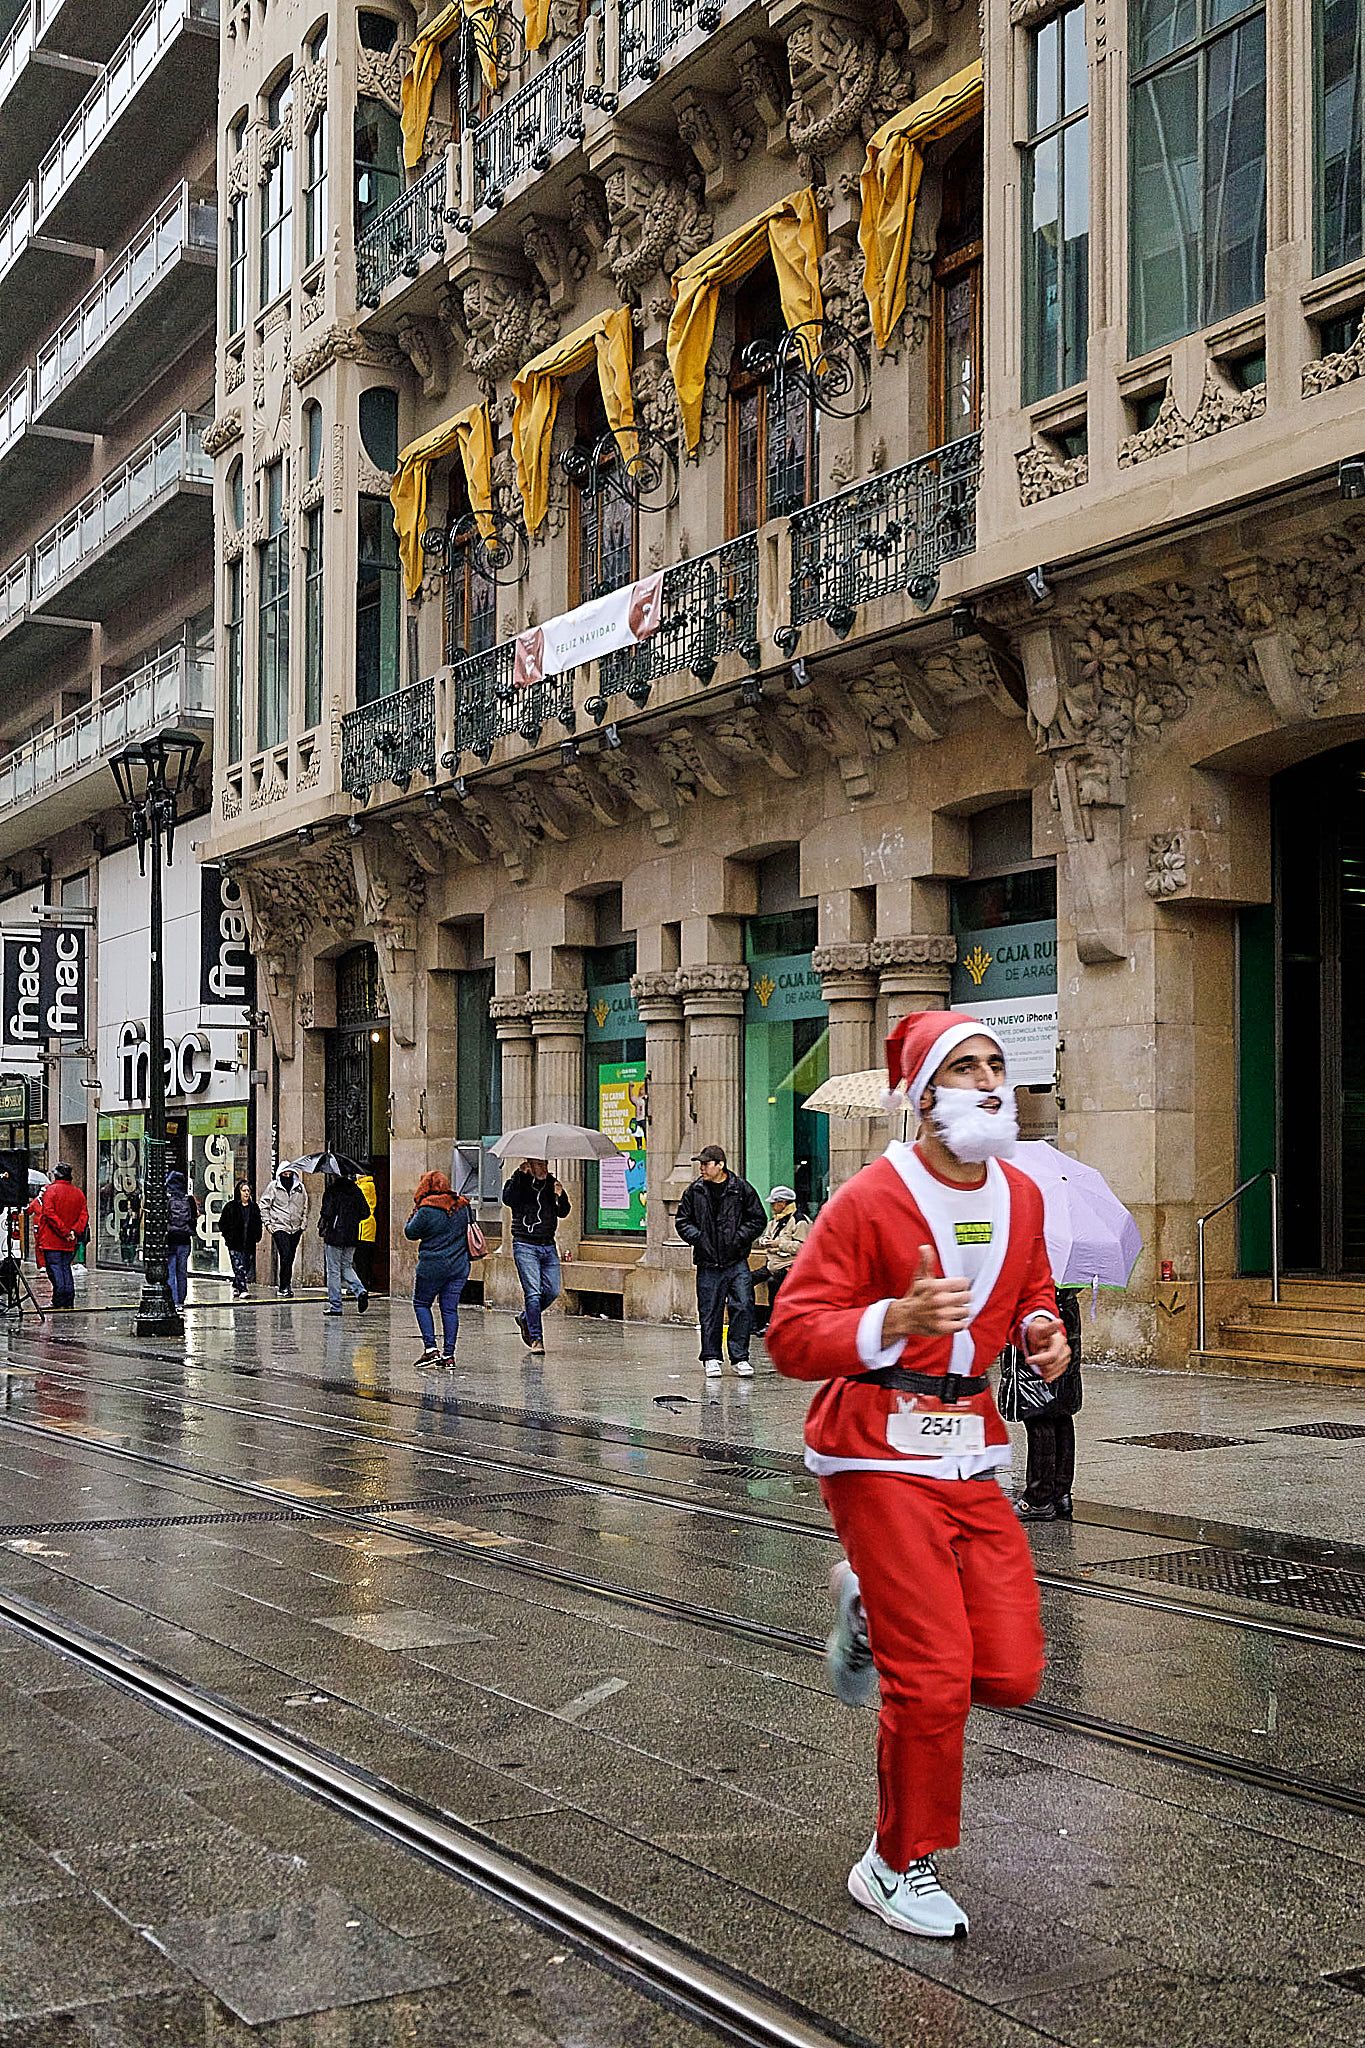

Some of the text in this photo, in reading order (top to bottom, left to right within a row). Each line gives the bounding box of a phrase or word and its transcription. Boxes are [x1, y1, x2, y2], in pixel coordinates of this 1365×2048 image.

[555, 638, 577, 656] FELIZ
[579, 622, 617, 645] NAVIDAD
[208, 877, 246, 998] fnac
[995, 944, 1029, 963] CAJA
[46, 932, 79, 1033] fnac
[778, 972, 805, 988] CAJA
[1005, 968, 1019, 981] DE
[9, 945, 40, 1040] fnac
[986, 1017, 996, 1026] TU
[997, 1014, 1025, 1025] NUEVO
[1026, 1012, 1053, 1022] iPhone
[195, 1134, 232, 1247] fnac
[921, 1416, 961, 1436] 2541
